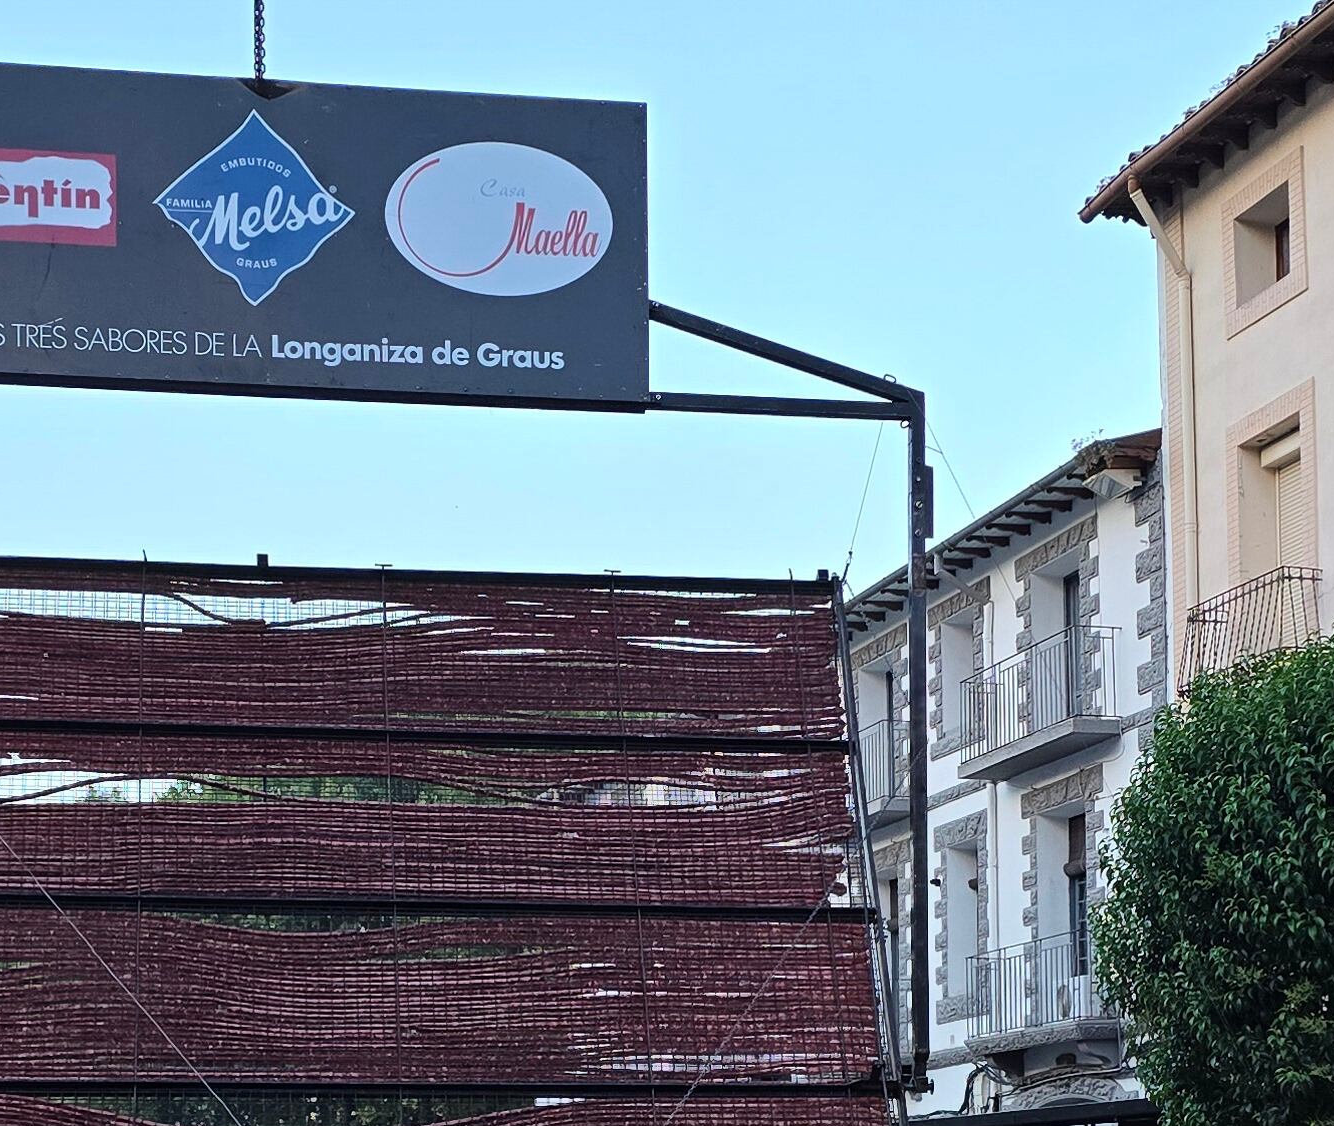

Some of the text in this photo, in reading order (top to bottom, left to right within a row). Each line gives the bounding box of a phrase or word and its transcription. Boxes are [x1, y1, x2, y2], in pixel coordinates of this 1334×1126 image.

[220, 157, 291, 178] EMBUTIDOS
[479, 178, 525, 198] Casa
[166, 198, 213, 209] FAMILIA
[189, 184, 344, 251] Melsa
[510, 201, 600, 257] Maella
[235, 257, 278, 269] GRAUS
[73, 326, 188, 355] SABORES
[194, 331, 225, 356] DE
[233, 333, 263, 358] LA
[271, 334, 424, 367] Longaniza
[431, 340, 470, 366] de
[476, 343, 565, 370] Graus
